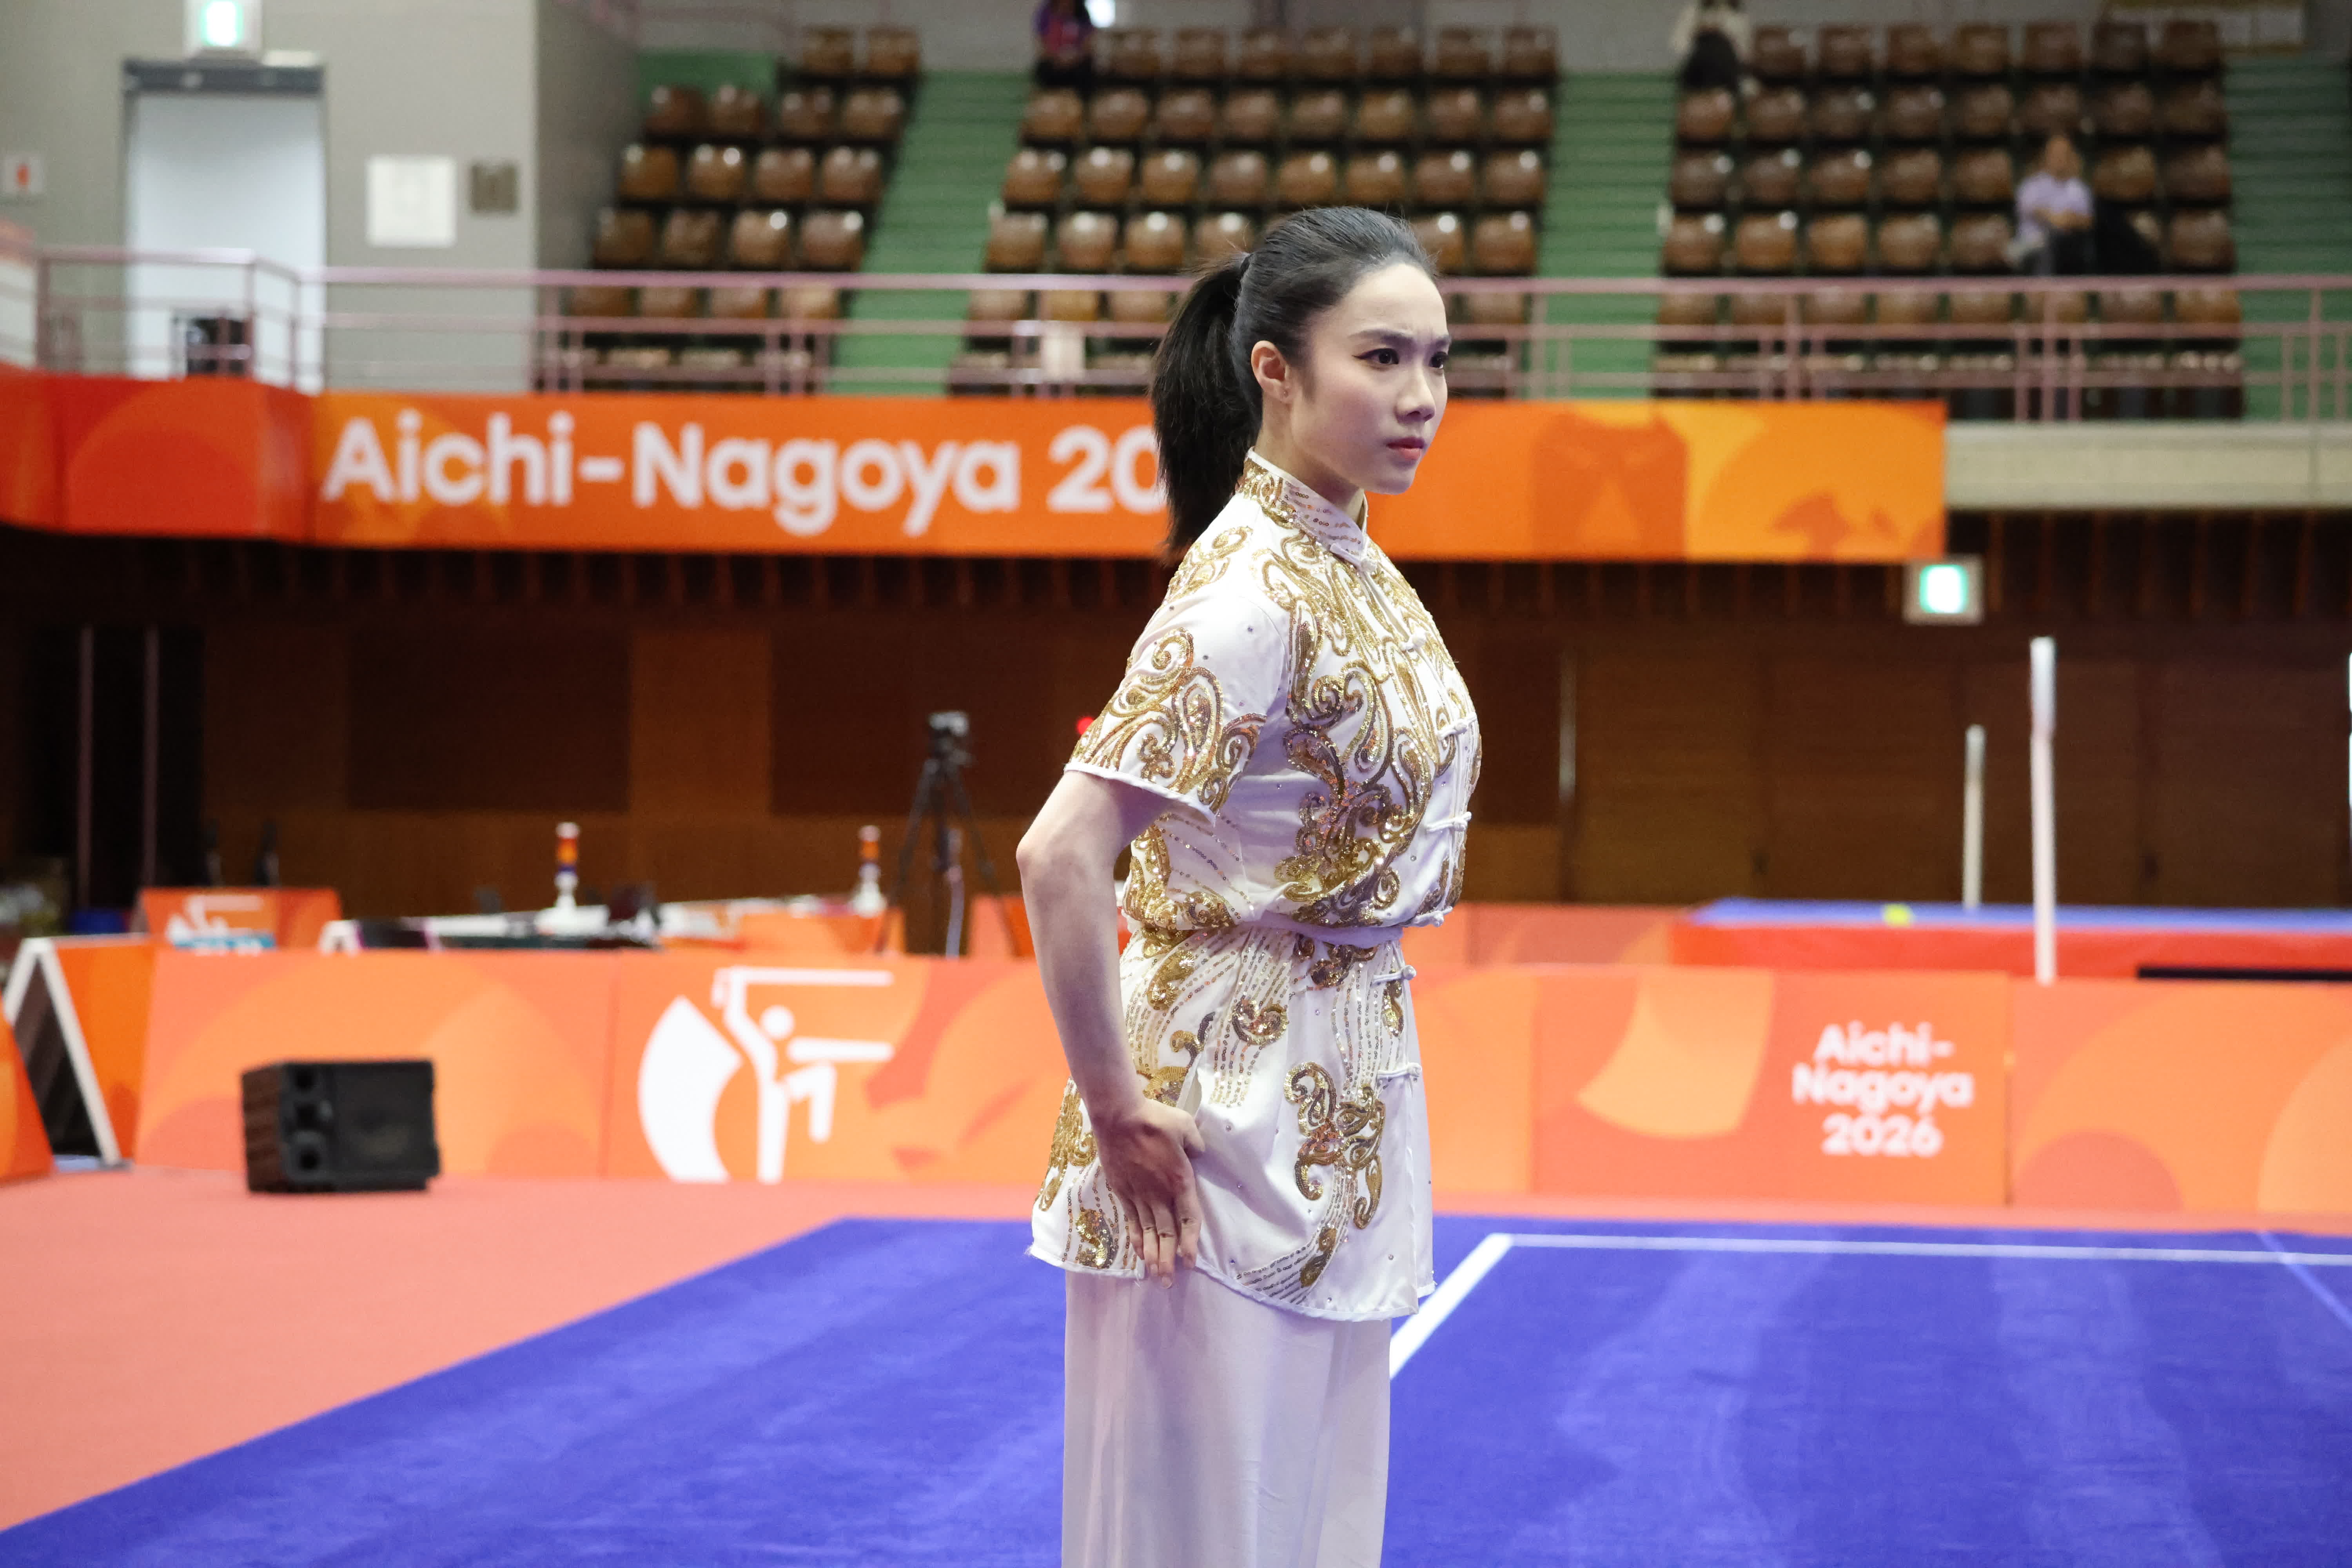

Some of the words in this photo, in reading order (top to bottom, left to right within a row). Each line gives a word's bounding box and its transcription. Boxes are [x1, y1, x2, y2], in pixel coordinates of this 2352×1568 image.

[325, 409, 1020, 536] Aichi-Nagoya
[1047, 425, 1165, 514] 20
[1813, 1020, 1954, 1066] Aichi-
[1792, 1062, 1975, 1115] Nagoya
[1822, 1114, 1944, 1157] 2026
